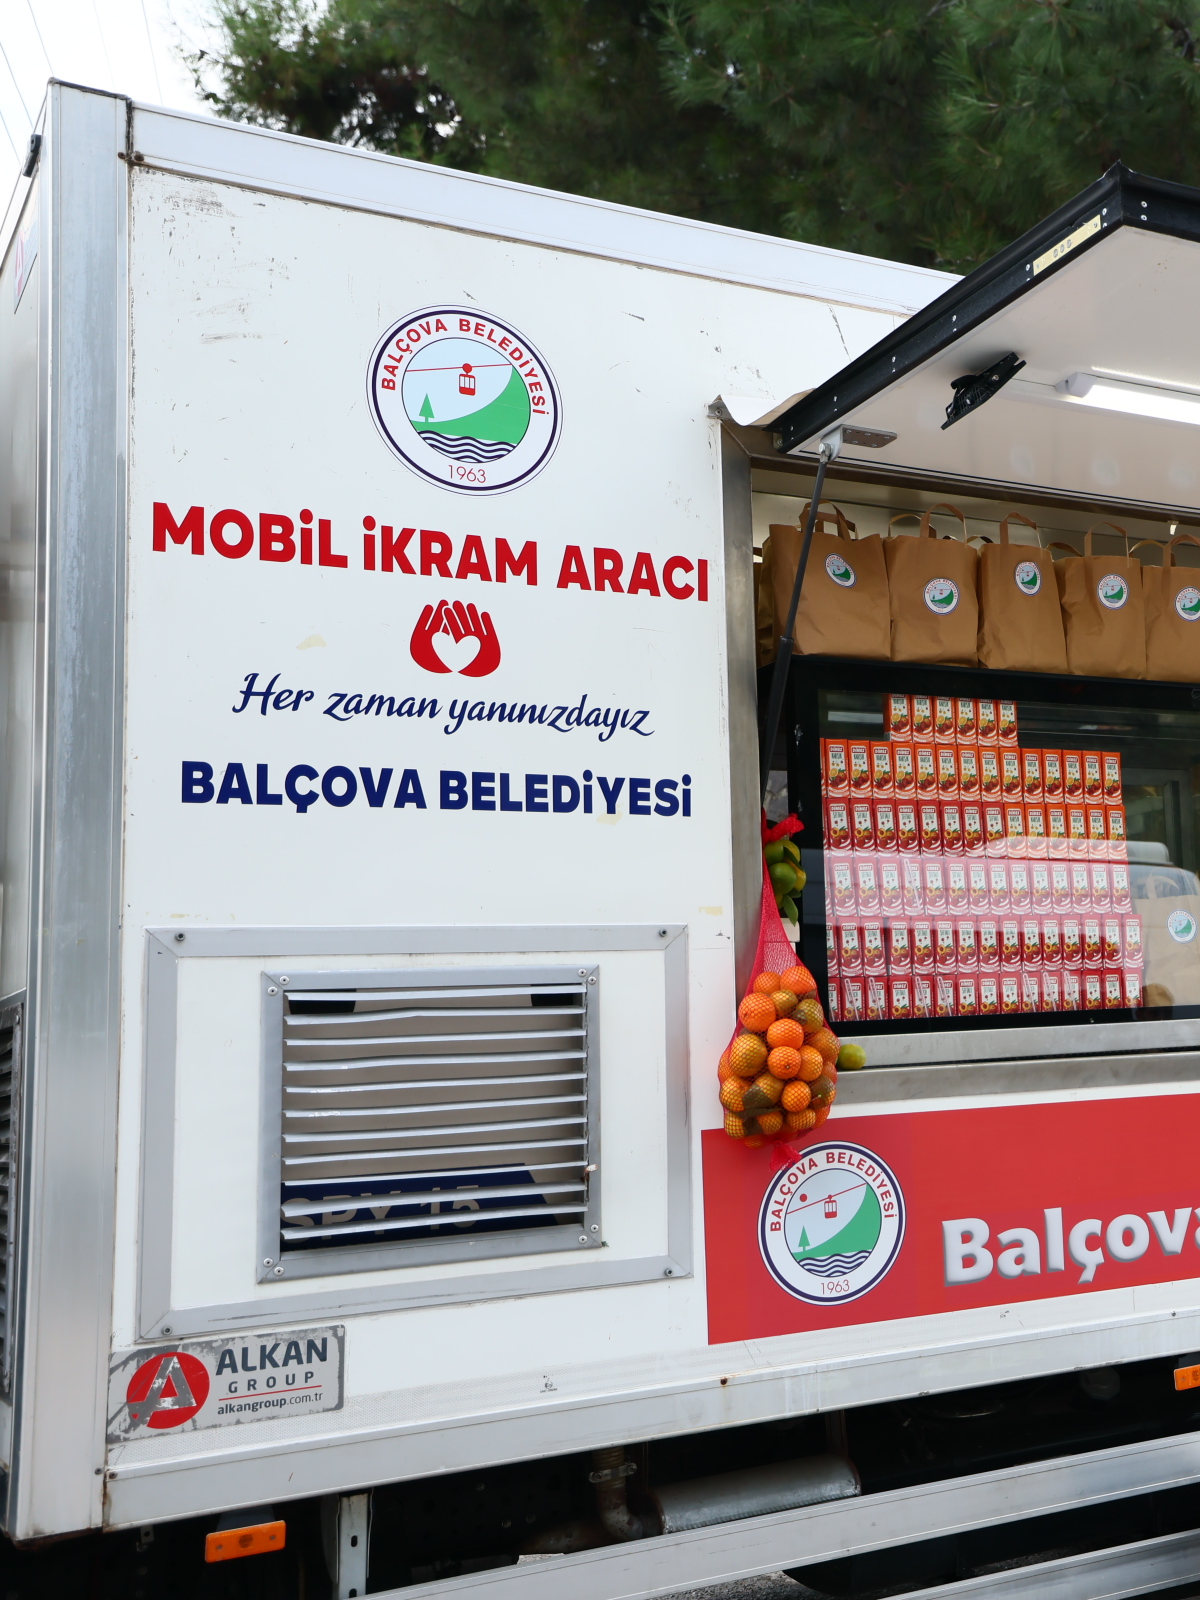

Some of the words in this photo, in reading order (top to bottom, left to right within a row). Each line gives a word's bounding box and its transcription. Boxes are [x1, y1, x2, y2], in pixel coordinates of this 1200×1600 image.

[382, 319, 448, 390] BALÇOVA
[459, 319, 549, 415] BELEDİYESİ
[448, 465, 486, 483] 1963
[557, 545, 708, 601] ARACI
[232, 673, 314, 716] Her
[323, 692, 441, 721] zaman
[444, 694, 655, 742] yanınızdayız
[182, 761, 427, 813] BALÇOVA
[439, 770, 691, 817] BELEDİYESİ
[770, 1158, 818, 1231] BALÇOVA
[826, 1152, 897, 1218] BELEDİYESİ
[821, 1279, 850, 1295] 1963
[216, 1337, 327, 1375] ALKAN
[218, 1391, 323, 1415] alkangroup.com.tr
[228, 1371, 314, 1394] GROUP
